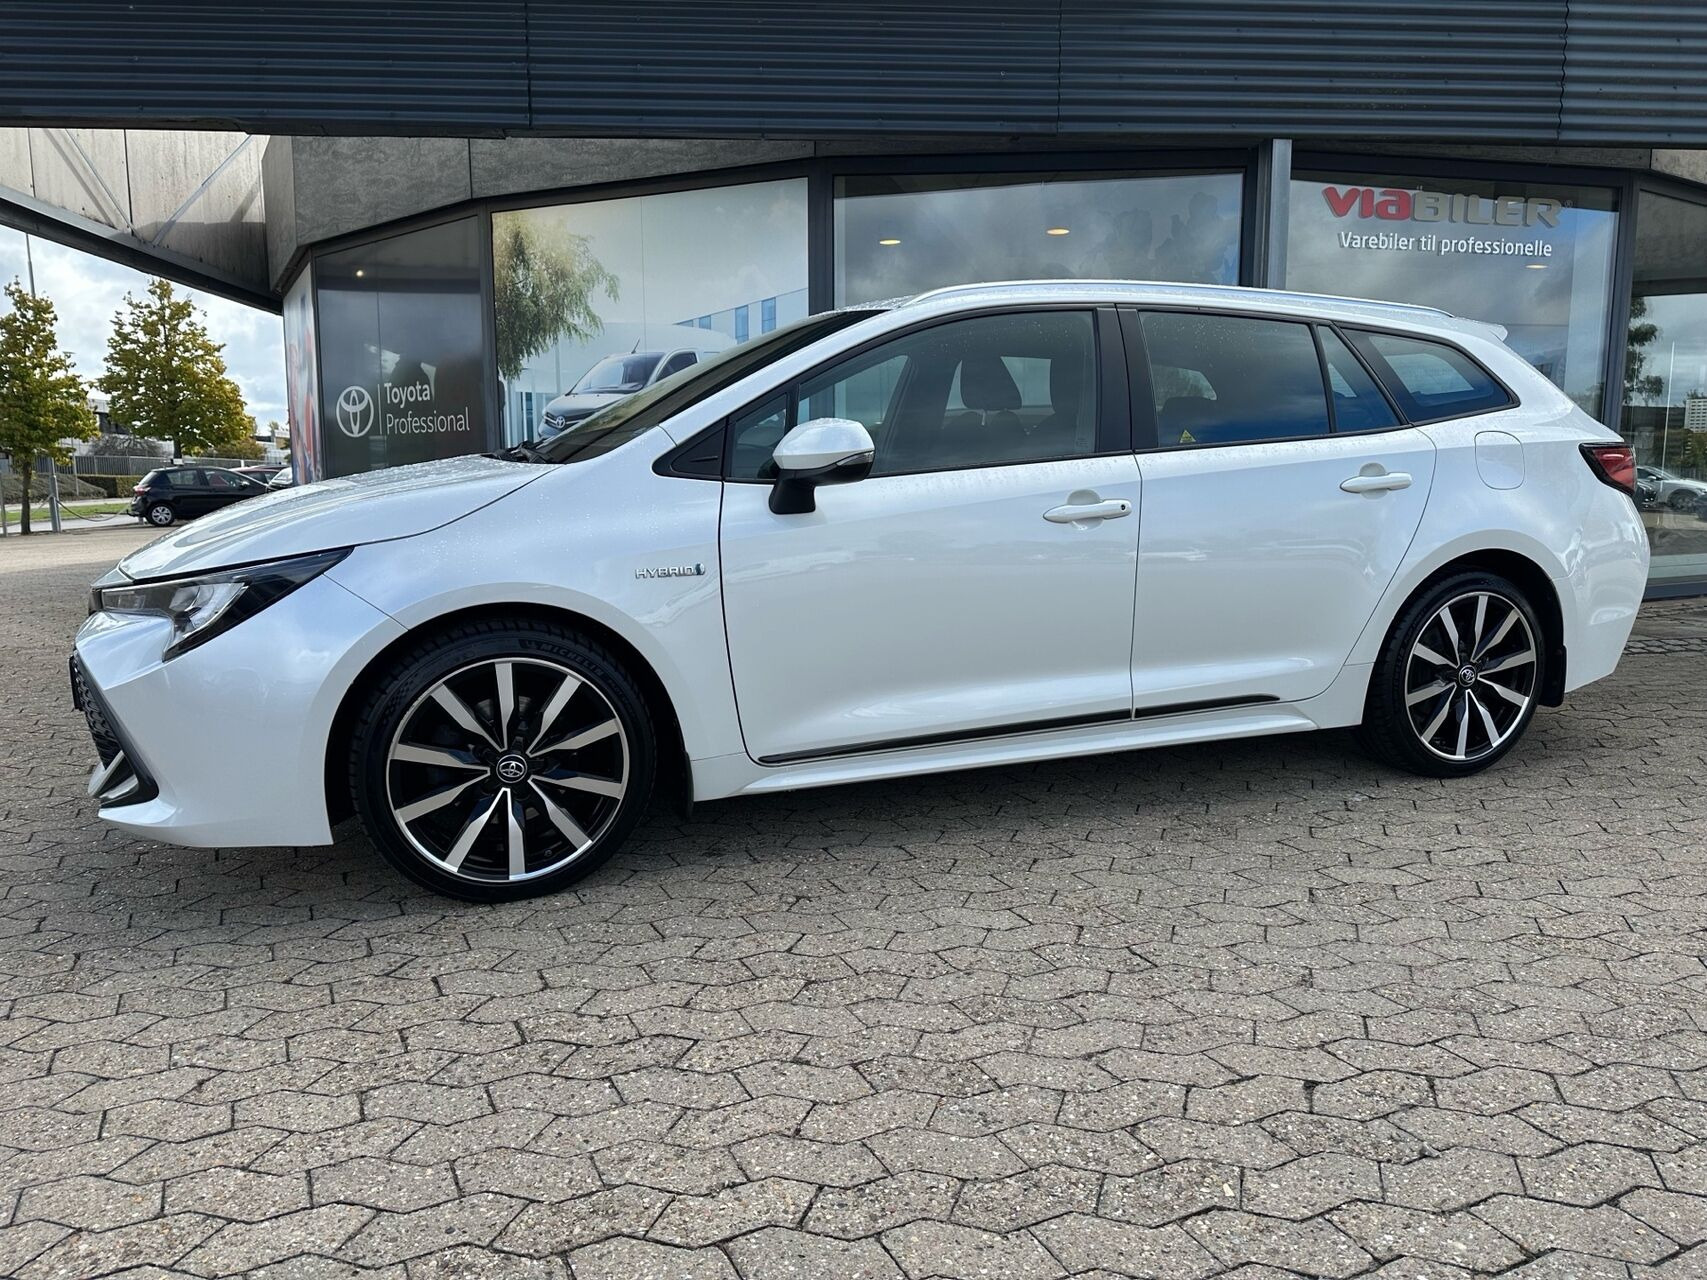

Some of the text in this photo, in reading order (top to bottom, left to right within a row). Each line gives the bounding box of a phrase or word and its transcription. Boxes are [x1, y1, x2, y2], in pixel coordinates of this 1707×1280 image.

[1340, 231, 1553, 257] Varebiler til professionelle
[383, 381, 431, 409] Toyota
[385, 406, 470, 435] Professional
[635, 565, 695, 580] HYBRID
[539, 642, 605, 678] MICHELIN
